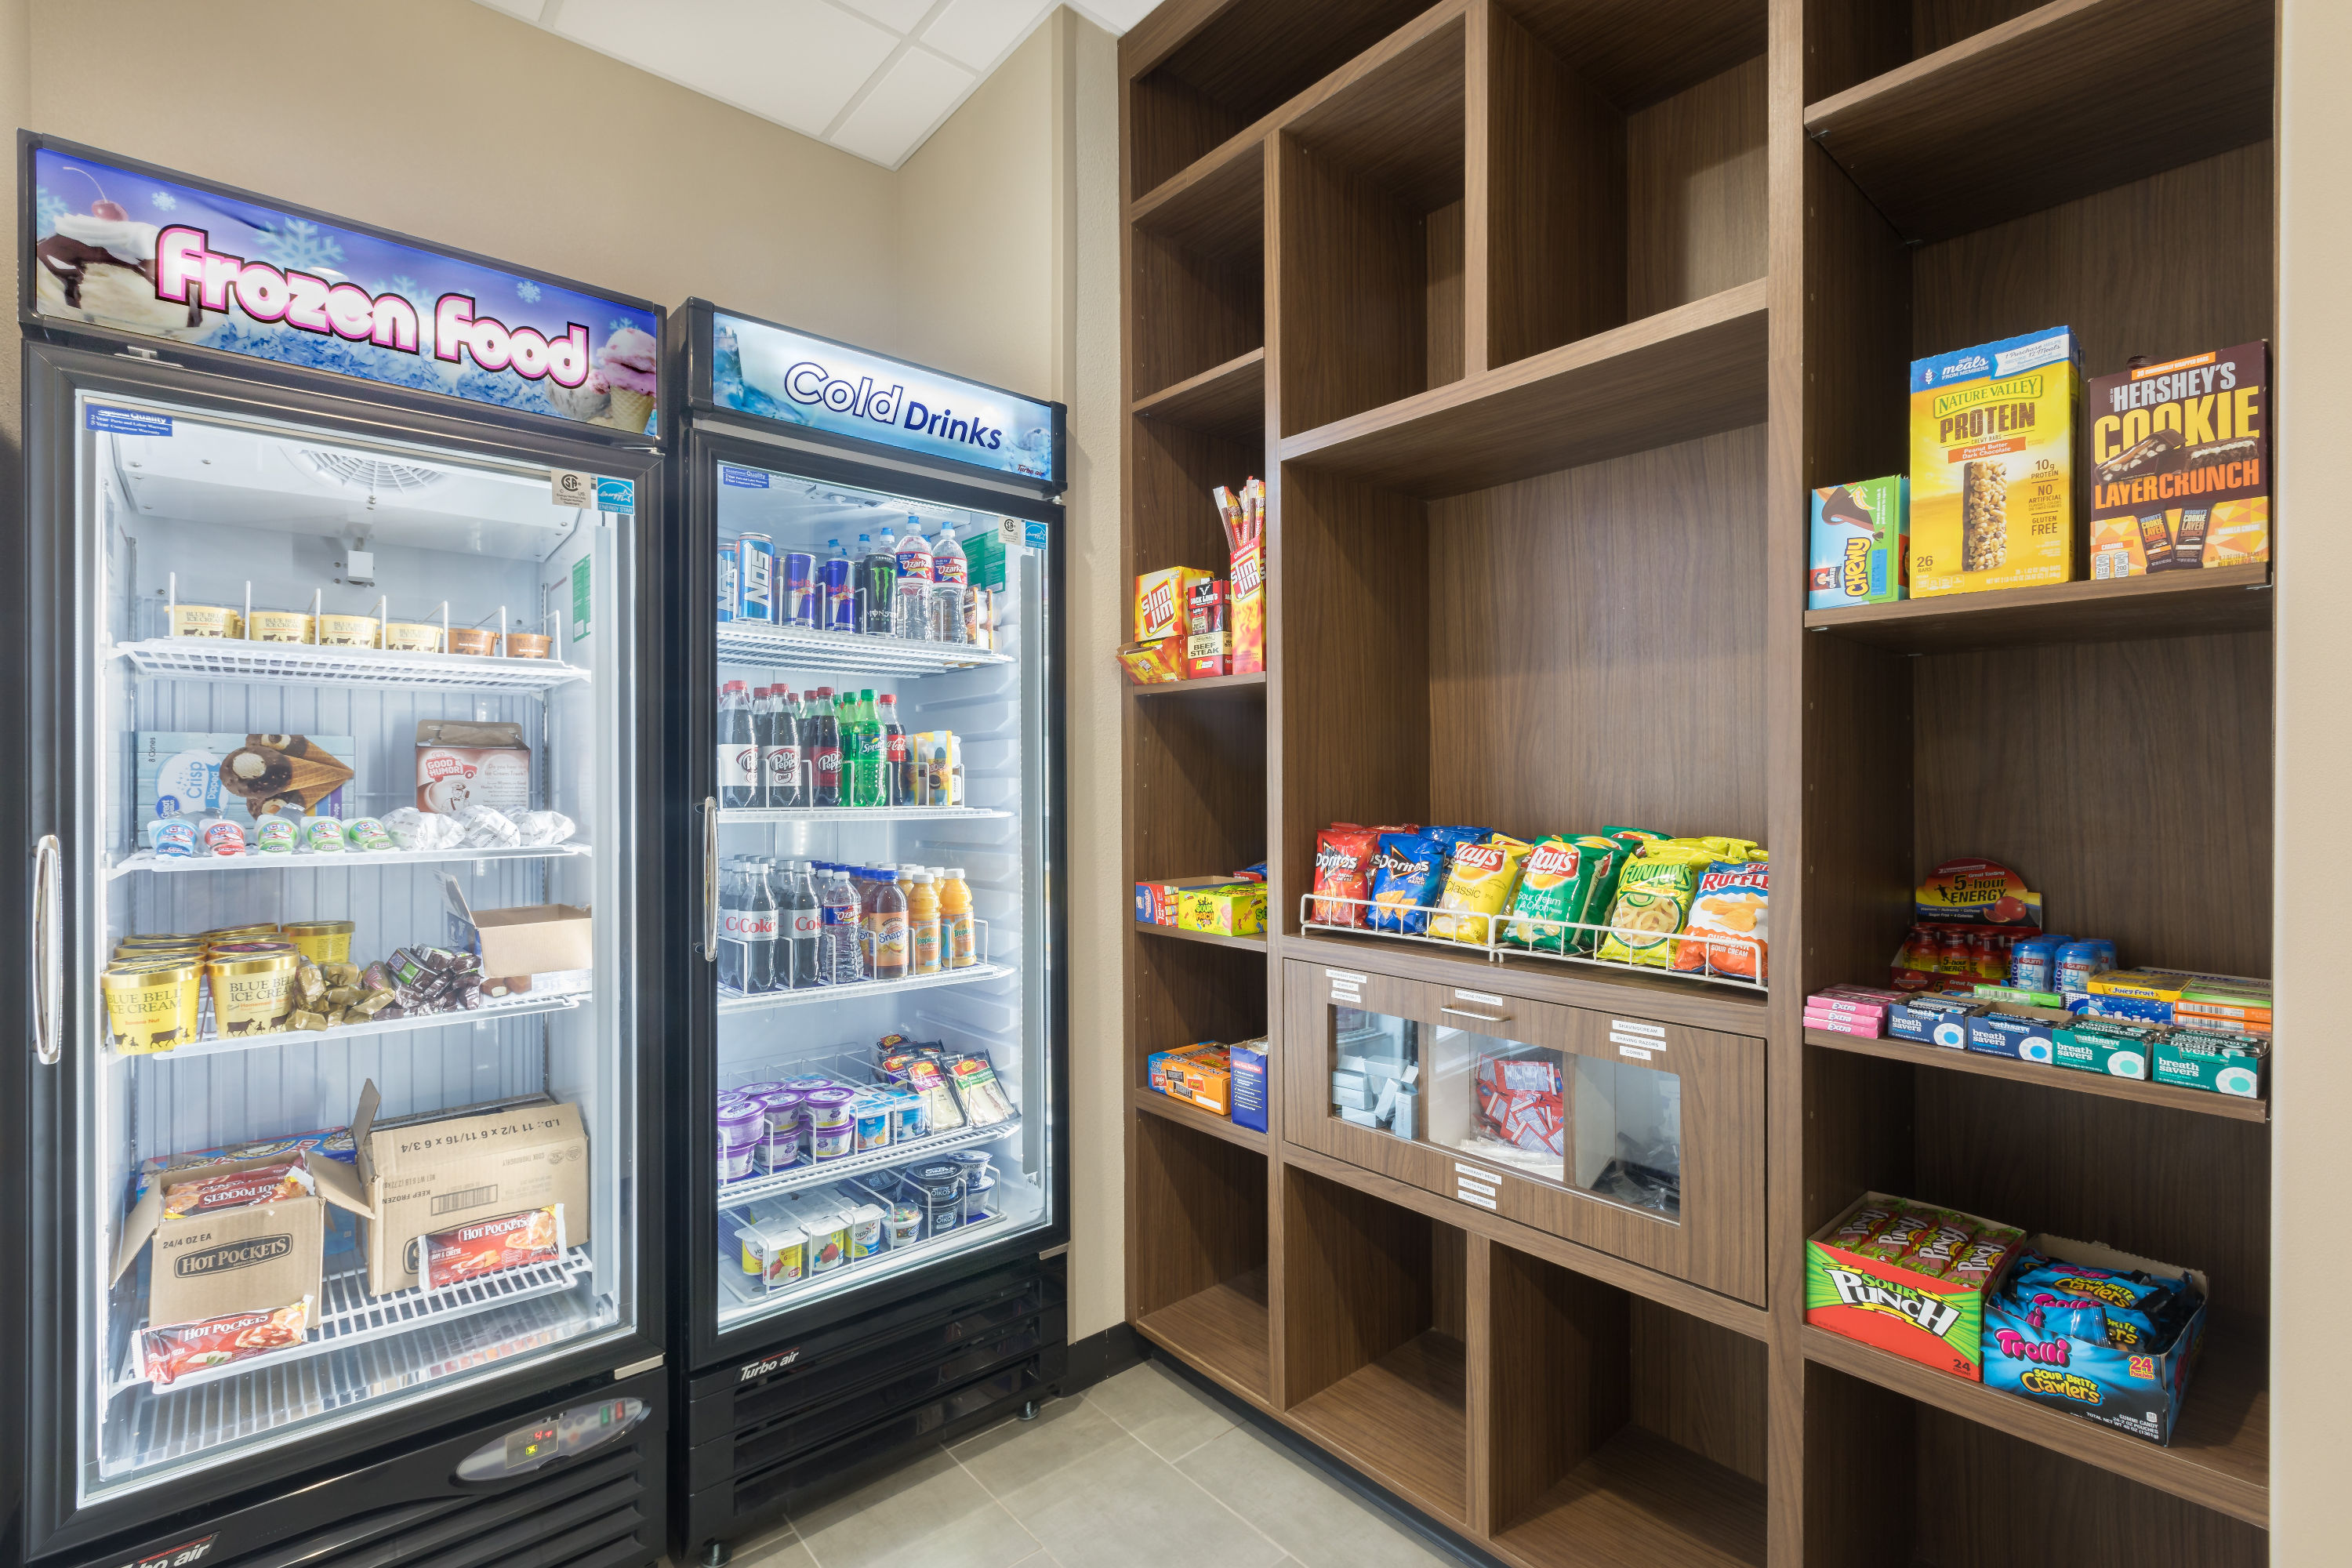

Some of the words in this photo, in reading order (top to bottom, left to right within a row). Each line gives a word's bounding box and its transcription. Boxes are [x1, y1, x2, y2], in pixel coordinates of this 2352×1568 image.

[2009, 345, 2042, 358] Purchase
[2038, 345, 2061, 355] Meals
[1942, 356, 1989, 376] meals
[1960, 366, 1989, 376] MEMBERS
[2114, 361, 2235, 412] HERSHEY'S
[1939, 390, 1988, 413] NATURE
[1990, 377, 2038, 397] VALLEY
[784, 361, 903, 426] Cold
[904, 401, 1002, 450] Drinks
[130, 412, 166, 423] Quality
[1940, 402, 2034, 443] PROTEIN
[2094, 386, 2259, 466] COOKIE
[1964, 445, 1986, 454] Peanut
[1979, 447, 2012, 456] Chocolate
[1018, 463, 1033, 475] Turbo
[2031, 470, 2059, 479] PROTEIN
[2038, 484, 2053, 495] NO
[2028, 495, 2062, 503] ARTIFICIAL
[599, 503, 619, 512] ENERGY
[2032, 515, 2057, 524] GLUTEN
[2141, 519, 2163, 529] COOKIE
[2032, 522, 2058, 535] FREE
[2143, 526, 2165, 536] LAYER
[2181, 521, 2205, 531] LAYER
[1233, 542, 1254, 559] ORIGINAL
[1916, 556, 1933, 568] 26
[744, 541, 769, 608] NOS
[787, 579, 804, 587] Red
[827, 584, 841, 593] Red
[1190, 648, 1219, 657] STEAK
[1193, 642, 1215, 651] BEEF
[1196, 660, 1203, 670] 12
[427, 760, 452, 769] GOOD
[429, 766, 460, 776] HUMOR
[187, 760, 206, 798] Crisp
[207, 771, 219, 800] Dipped
[162, 800, 170, 818] Great
[1316, 853, 1358, 870] Doritos
[1379, 855, 1429, 872] Doritos
[1526, 847, 1577, 874] Lay's
[1619, 863, 1693, 892] FUNYUNS
[1954, 874, 2007, 891] 5-hour
[1445, 880, 1481, 898] Classic
[1518, 891, 1534, 902] Sour
[1534, 894, 1561, 906] Cream
[1950, 888, 2007, 903] ENERGY
[1196, 904, 1214, 913] SOUR
[1526, 901, 1549, 912] Onion
[1196, 912, 1214, 920] PATCH
[740, 917, 776, 934] Coke
[1711, 944, 1726, 953] SOUR
[1728, 947, 1748, 957] CREAM
[230, 981, 267, 993] BLUE
[2112, 986, 2133, 996] Juicy
[2134, 989, 2156, 998] Fruit
[108, 994, 139, 1004] BLUE
[143, 989, 183, 1003] BELL
[230, 993, 249, 1002] ICE
[127, 1000, 182, 1014] CREAM
[1831, 1002, 1856, 1011] Extra
[1828, 1013, 1852, 1022] Extra
[1892, 1015, 1922, 1028] breath
[1827, 1023, 1852, 1033] Extra
[1892, 1022, 1922, 1033] savers
[1973, 1029, 2005, 1041] breath
[1973, 1036, 2005, 1047] savers
[2056, 1042, 2093, 1055] breath
[2056, 1049, 2093, 1061] savers
[2158, 1057, 2200, 1071] breath
[2158, 1065, 2200, 1077] savers
[501, 1125, 517, 1135] 1/2
[522, 1123, 533, 1131] 11
[446, 1132, 477, 1145] 11/16
[401, 1142, 421, 1153] 3/4
[203, 1188, 253, 1205] POCKETS
[382, 1192, 412, 1204] FROZEN
[418, 1189, 430, 1198] KEEP
[463, 1227, 484, 1241] HOT
[485, 1218, 527, 1236] POCKETS
[163, 1238, 183, 1249] 24/4
[185, 1235, 198, 1244] OZ
[200, 1232, 212, 1241] EA
[181, 1256, 216, 1275] HOT
[218, 1237, 288, 1267] POCKETS
[445, 1247, 462, 1257] CHEESE
[2054, 1278, 2131, 1308] Crawlers
[184, 1327, 210, 1342] HOT
[212, 1313, 269, 1336] POCKETS
[1994, 1329, 2069, 1365] Trolli
[741, 1361, 777, 1381] Turbo
[780, 1351, 799, 1366] air
[1953, 1359, 1971, 1371] 24
[2129, 1356, 2154, 1374] 24
[1953, 1367, 1971, 1376] COUNT
[2034, 1368, 2063, 1382] SOUR
[2130, 1370, 2154, 1380] Pouches
[2021, 1372, 2101, 1404] Crawlers
[2086, 1411, 2103, 1421] TOTAL
[2119, 1414, 2139, 1424] GUMMI
[2140, 1421, 2158, 1429] CANDY
[2133, 1424, 2158, 1434] POUCHES
[173, 1544, 210, 1567] air
